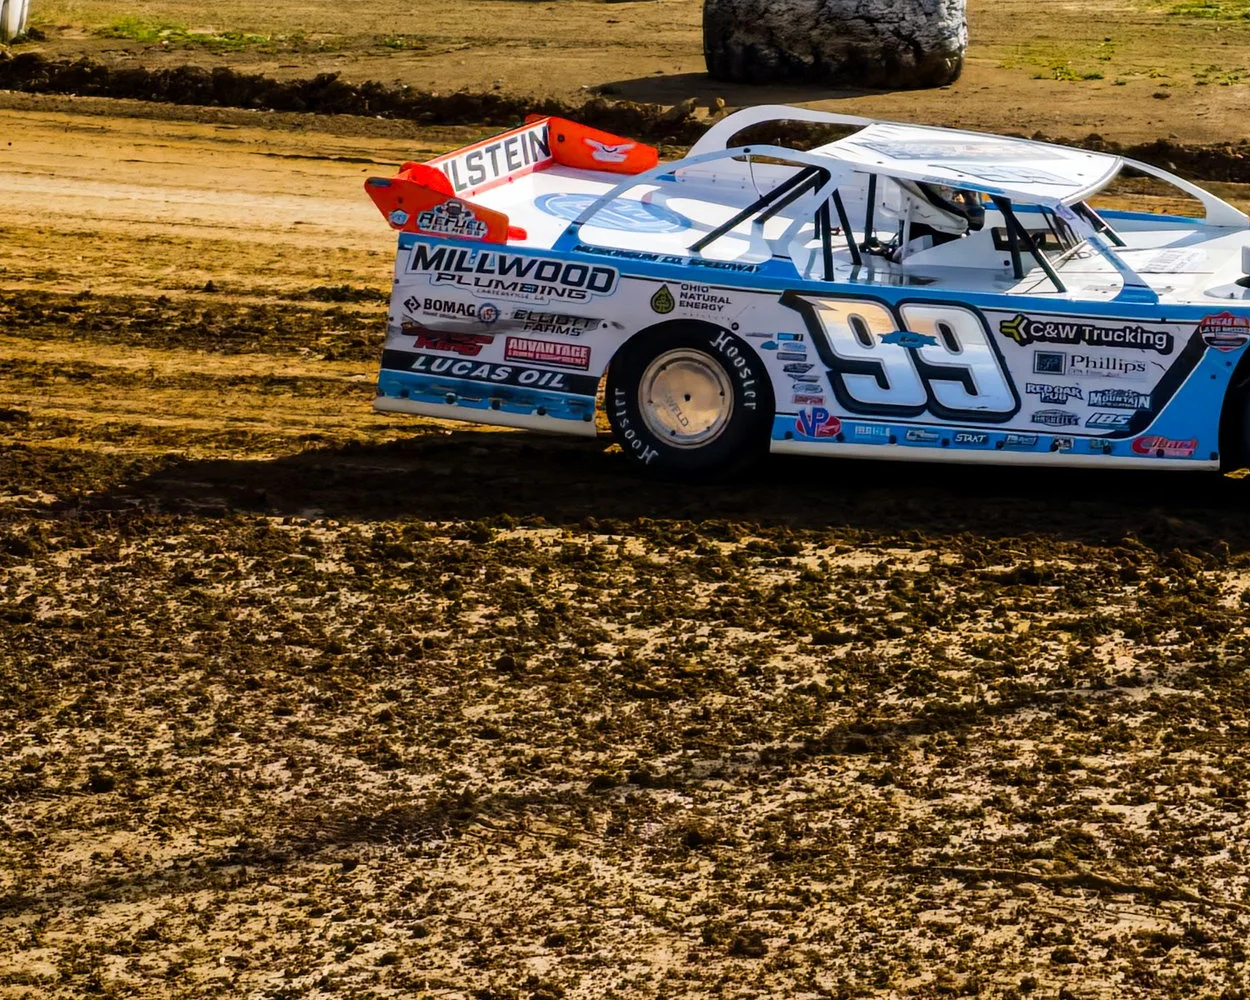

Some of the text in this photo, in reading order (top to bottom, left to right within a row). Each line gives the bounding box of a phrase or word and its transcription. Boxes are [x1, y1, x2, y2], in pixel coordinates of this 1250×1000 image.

[442, 125, 551, 192] ILSTEIN
[420, 212, 484, 231] REFUEL
[411, 245, 616, 293] MILLWOOD
[435, 273, 587, 300] PLUMBING
[680, 292, 732, 304] NATURAL
[681, 283, 709, 293] OHIO
[423, 298, 476, 317] BOMAG
[679, 300, 724, 312] ENERGY
[523, 322, 582, 336] FARMS
[1030, 321, 1168, 349] C&W Trucking
[508, 338, 588, 358] ADVANTAGE
[800, 292, 1020, 420] 99
[411, 356, 565, 388] LUCAS OIL
[709, 330, 757, 410] Hoosier
[1070, 354, 1146, 373] Phillips
[614, 388, 659, 465] Hoosier
[799, 407, 829, 437] VP
